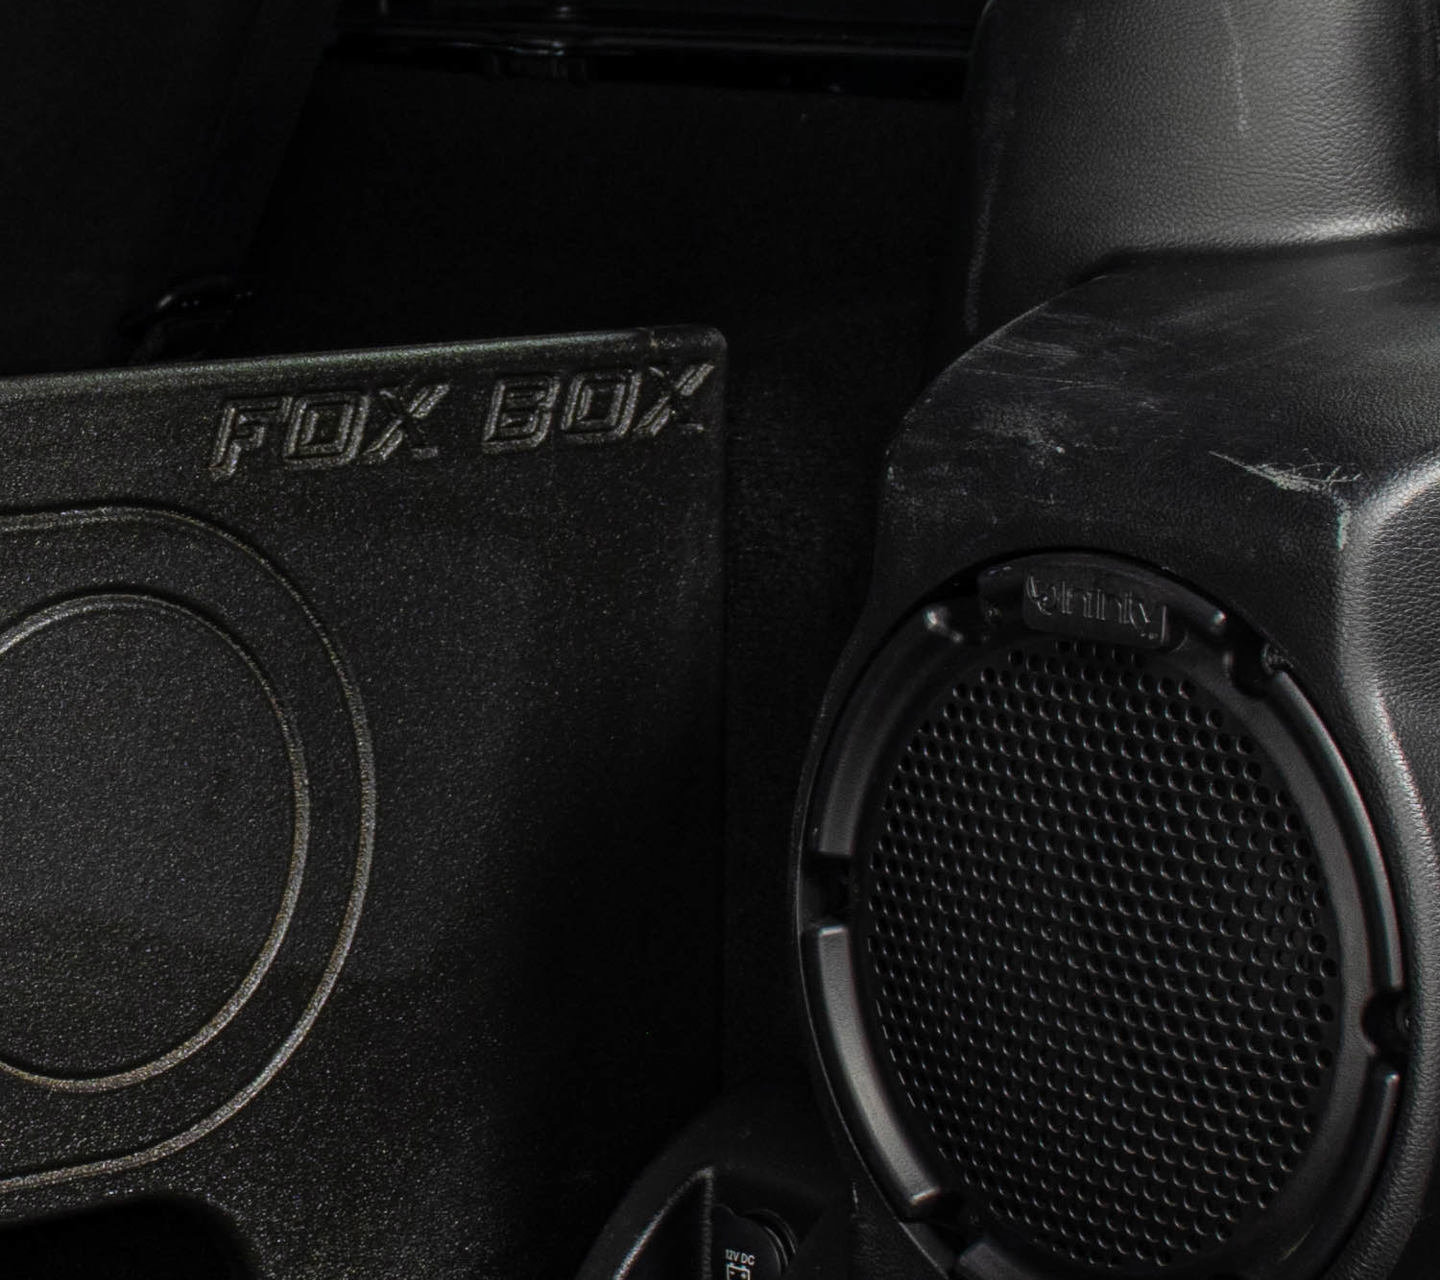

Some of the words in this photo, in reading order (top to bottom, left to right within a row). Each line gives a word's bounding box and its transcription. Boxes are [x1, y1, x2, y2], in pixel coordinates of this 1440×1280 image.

[209, 381, 451, 479] FOX
[481, 362, 716, 456] BOX
[725, 1248, 740, 1262] 12V
[740, 1252, 756, 1267] DC
